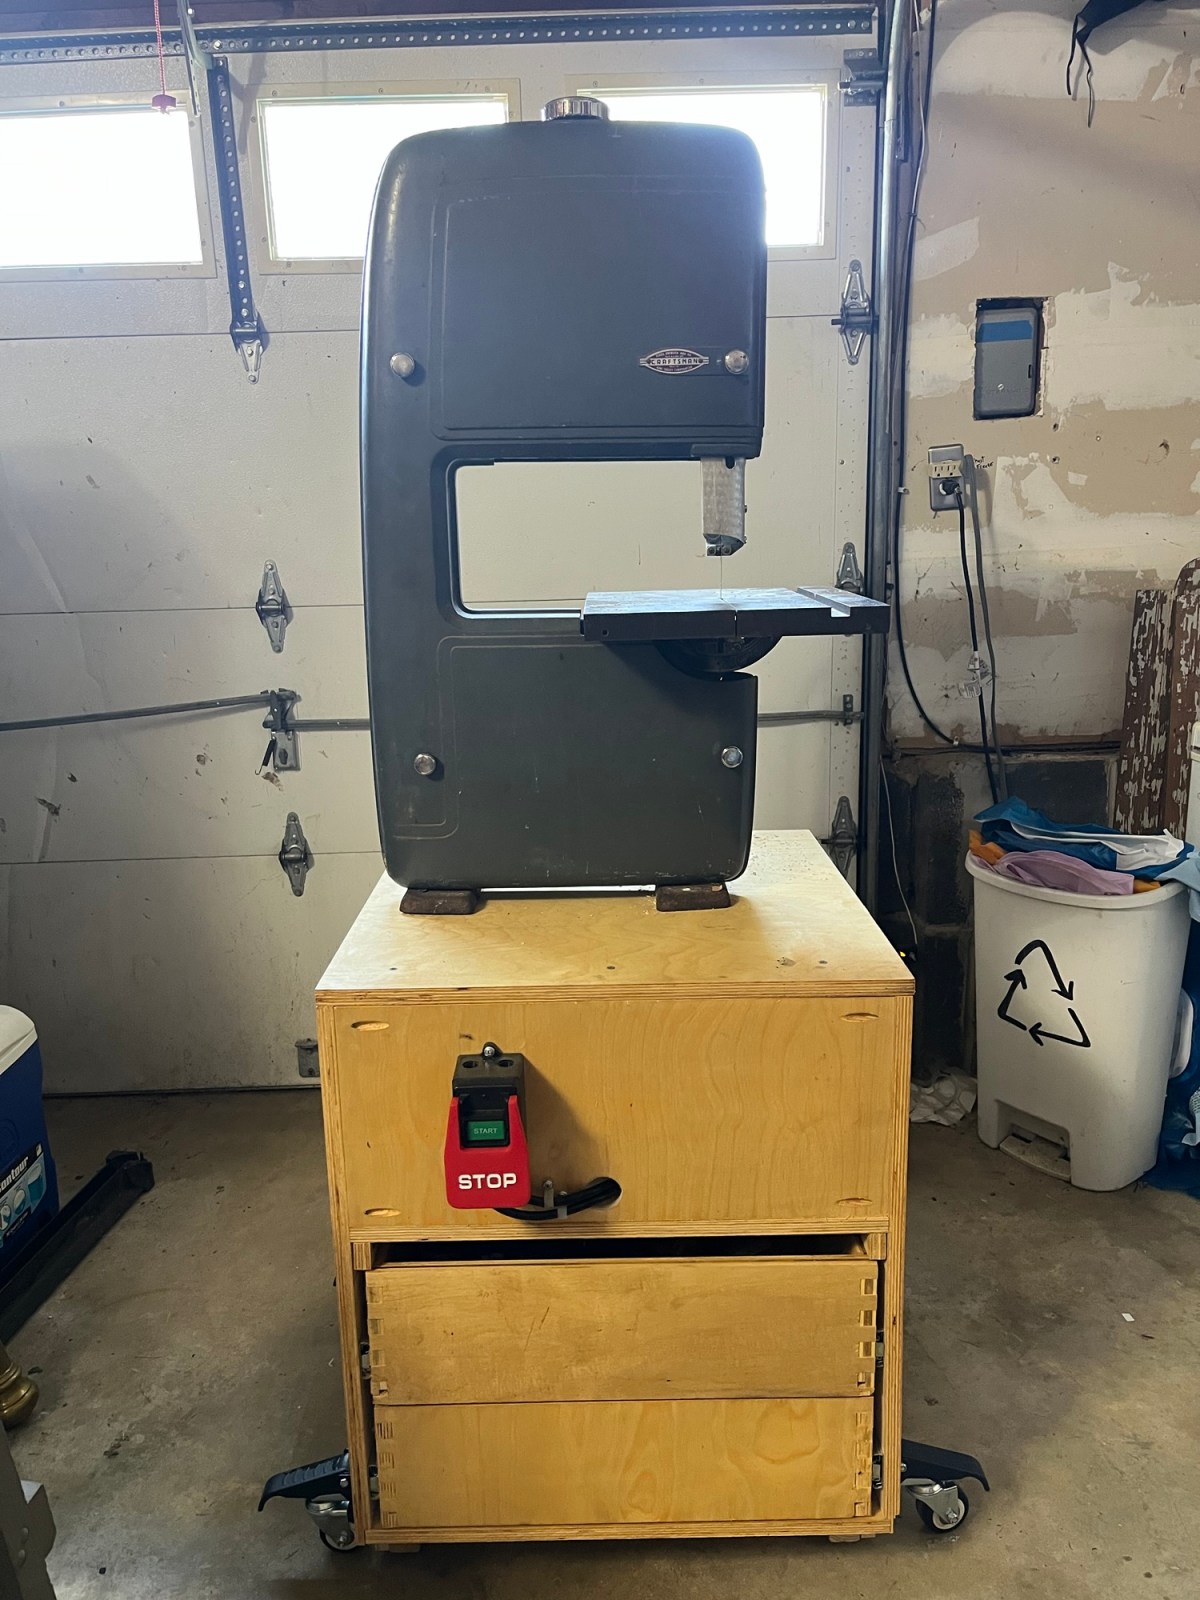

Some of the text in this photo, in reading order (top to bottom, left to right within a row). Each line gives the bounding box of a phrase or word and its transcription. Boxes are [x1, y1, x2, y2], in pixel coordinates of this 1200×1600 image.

[474, 1127, 498, 1135] START
[0, 1156, 29, 1193] ontour
[458, 1172, 517, 1190] STOP
